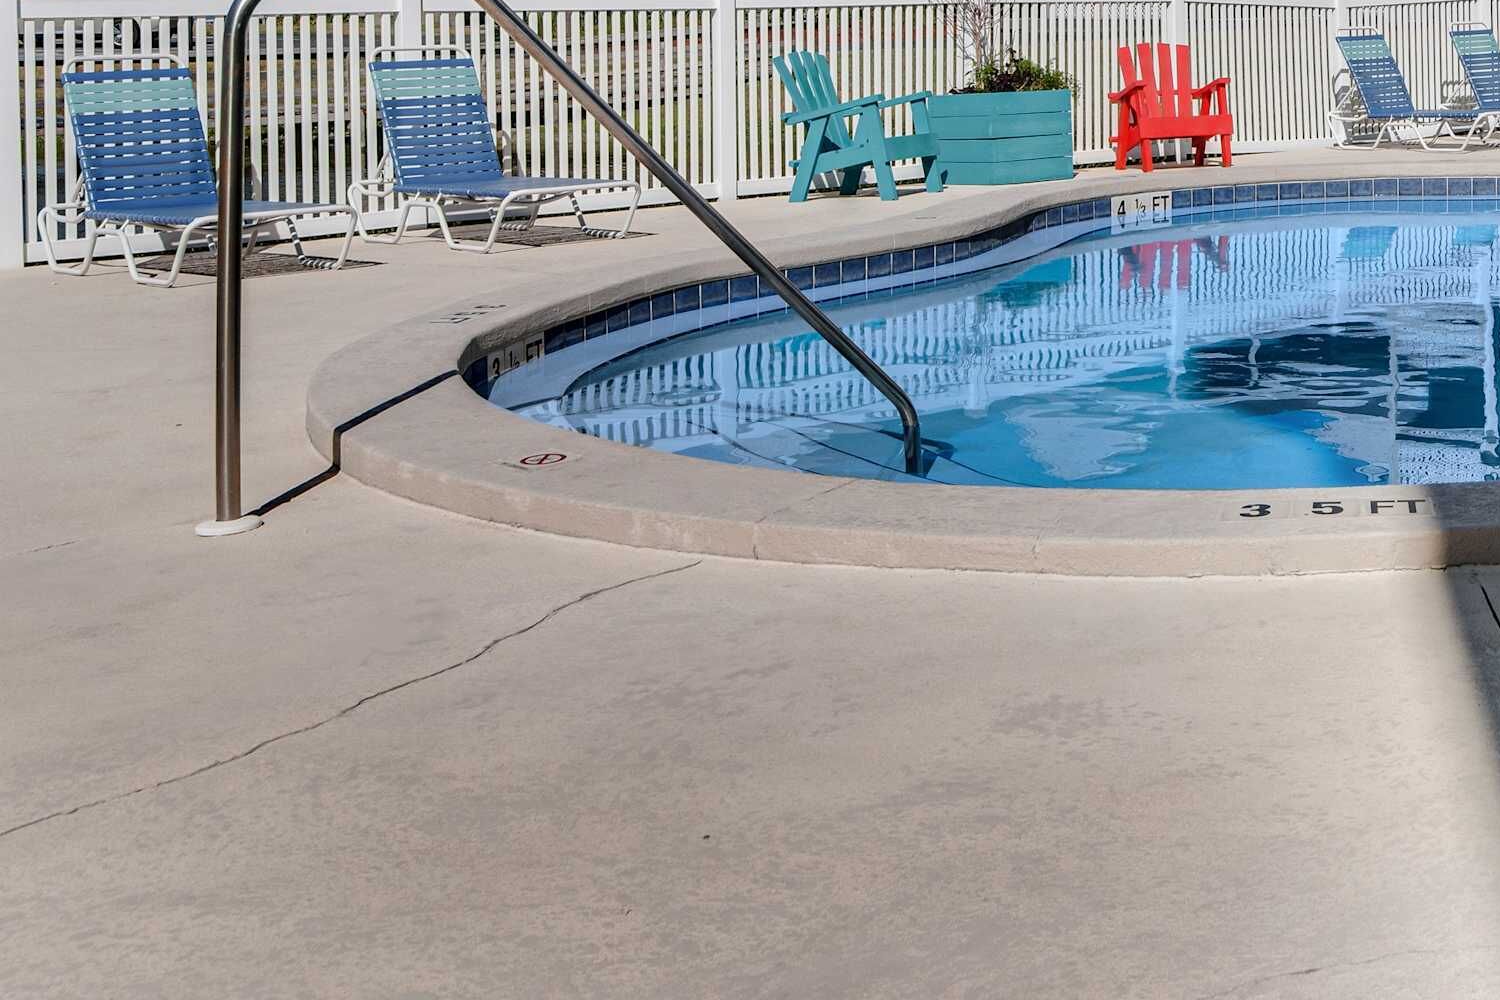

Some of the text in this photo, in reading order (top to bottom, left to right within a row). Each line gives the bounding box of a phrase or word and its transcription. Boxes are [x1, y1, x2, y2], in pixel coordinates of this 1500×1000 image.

[1117, 199, 1126, 216] 4
[1152, 195, 1169, 213] FT
[526, 339, 543, 363] FT
[1240, 504, 1271, 517] 3
[1370, 500, 1426, 514] FT
